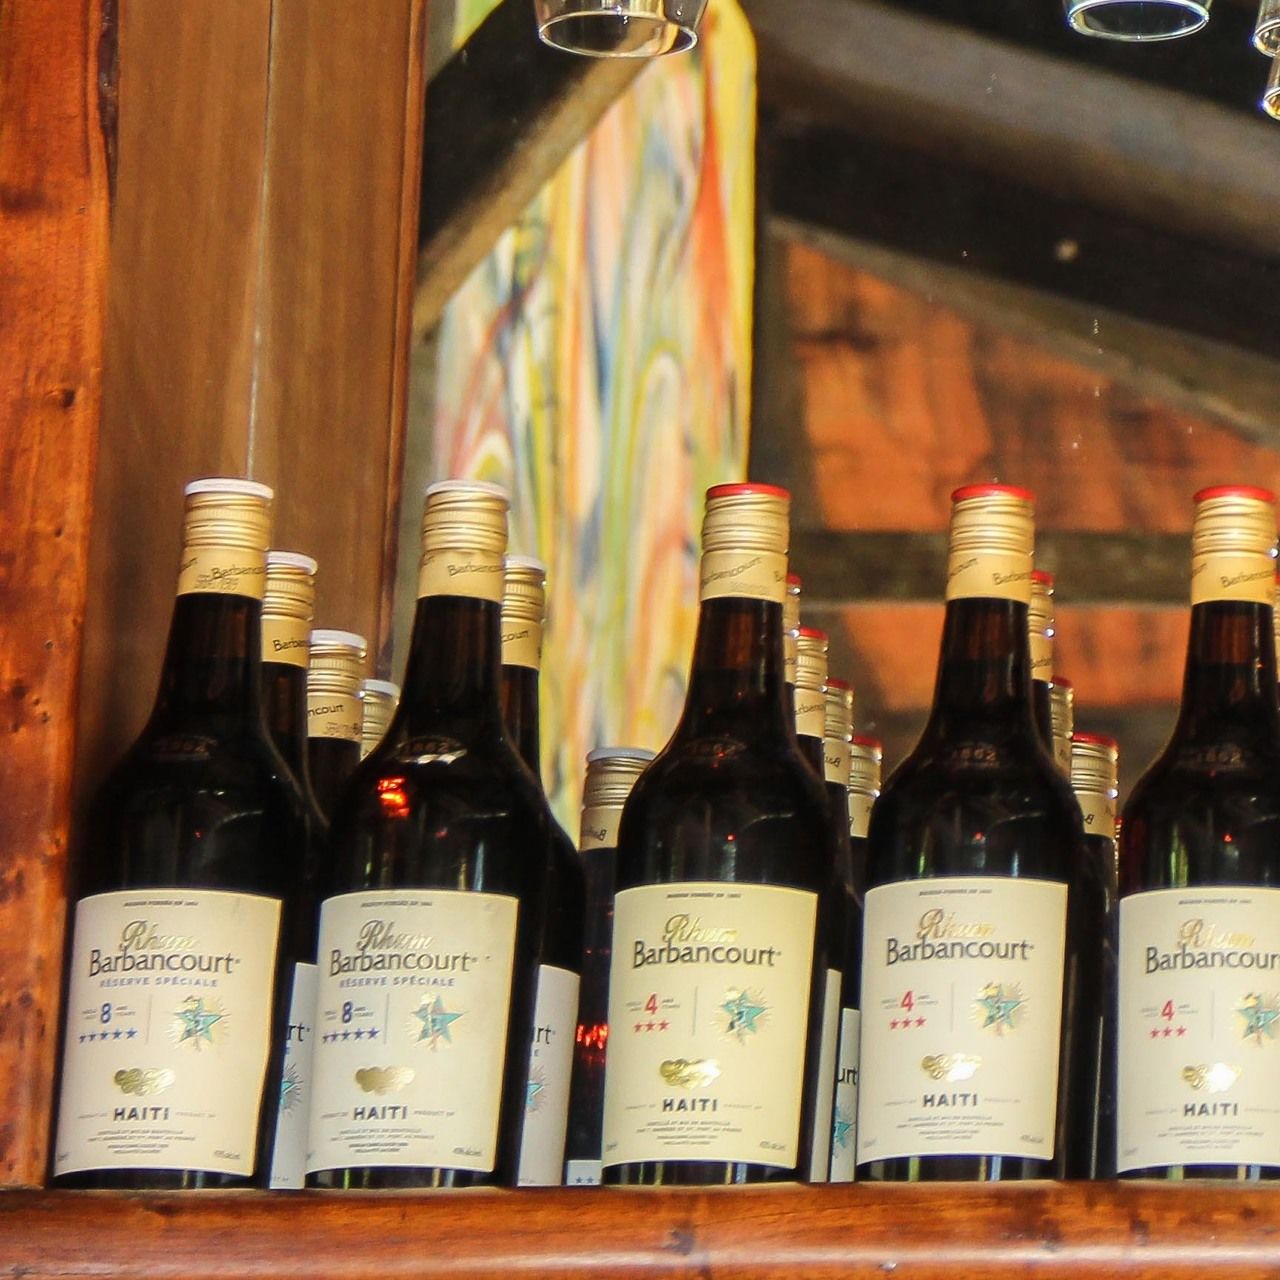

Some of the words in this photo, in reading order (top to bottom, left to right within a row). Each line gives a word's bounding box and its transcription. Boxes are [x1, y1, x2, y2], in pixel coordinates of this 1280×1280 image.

[89, 945, 235, 977] Barbancourt
[329, 947, 471, 977] Barbancourt
[633, 940, 775, 969] Barbancourt
[886, 937, 1029, 966] Barbancourt
[156, 977, 218, 988] SPÉCIALE
[394, 976, 456, 988] SPÉCIALE
[342, 1000, 353, 1024] 8
[645, 993, 658, 1015] 4
[900, 990, 914, 1012] 4
[1161, 999, 1175, 1021] 4
[100, 1002, 112, 1024] 8
[662, 1098, 718, 1112] HAITI
[923, 1093, 978, 1107] HAITI
[1184, 1103, 1239, 1117] HAITI
[113, 1107, 170, 1122] HAITI
[353, 1106, 408, 1121] HAITI
